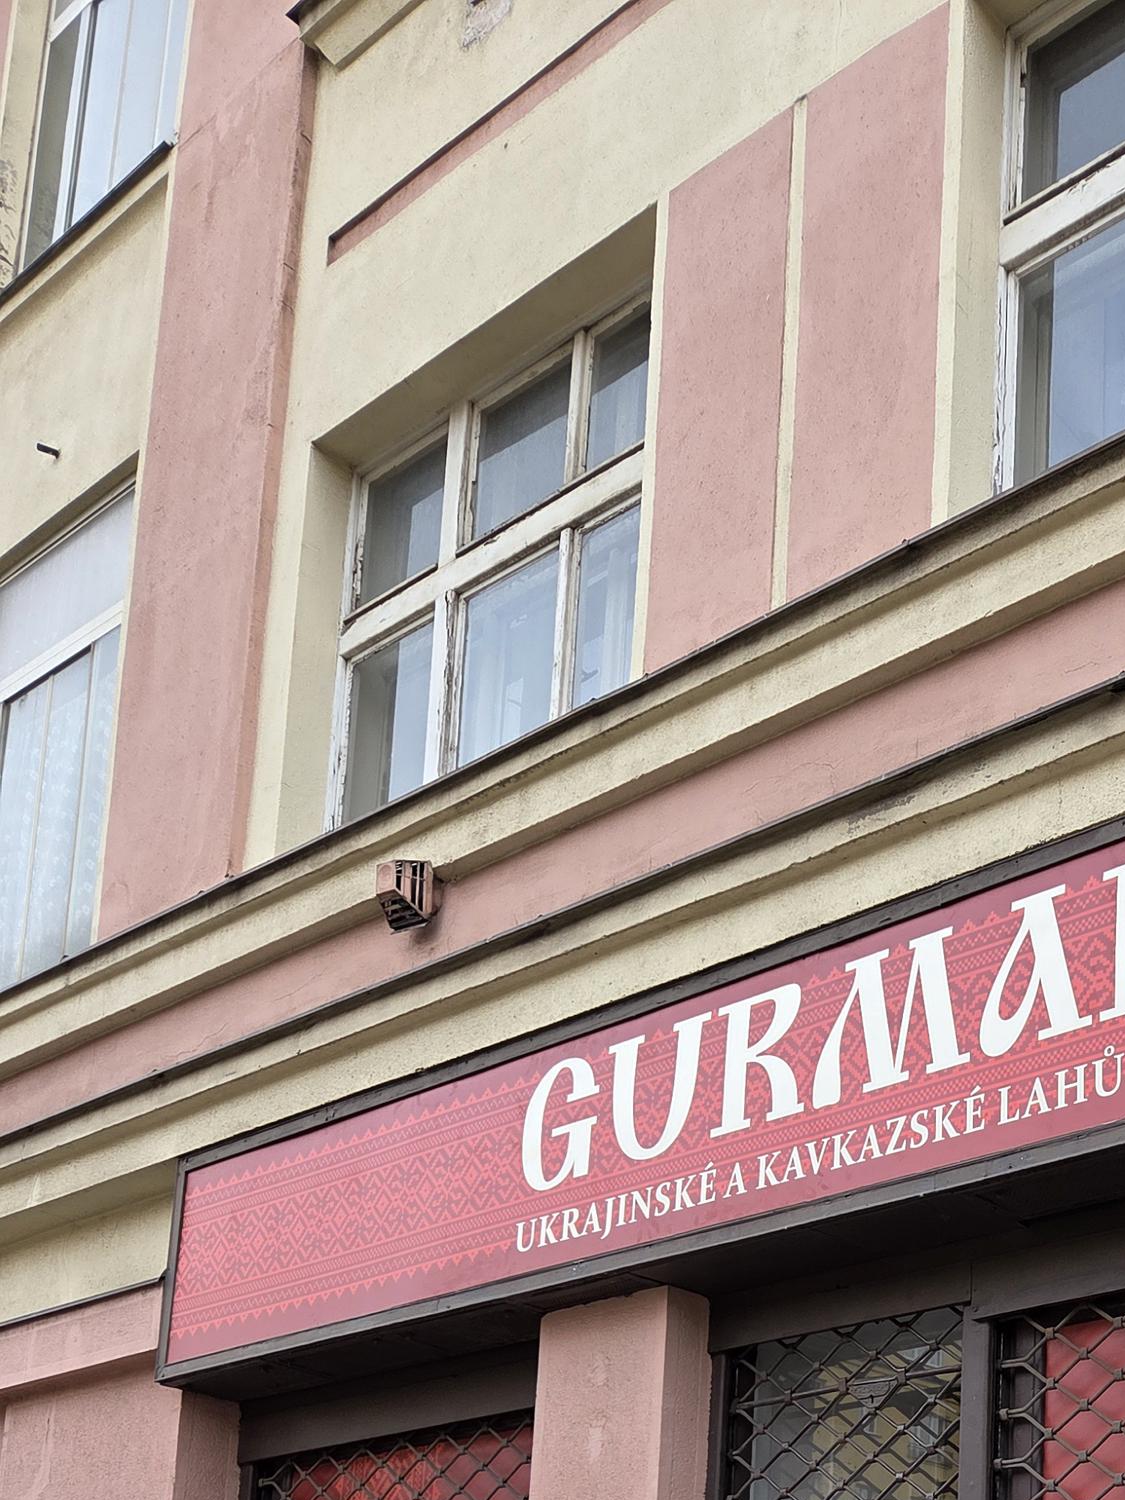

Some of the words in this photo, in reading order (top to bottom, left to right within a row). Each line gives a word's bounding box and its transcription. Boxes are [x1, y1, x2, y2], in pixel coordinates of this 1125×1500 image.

[516, 1162, 717, 1252] UKRAJINSKÉ
[723, 1163, 748, 1199] A
[756, 1086, 986, 1190] KAVKAZSKÉ
